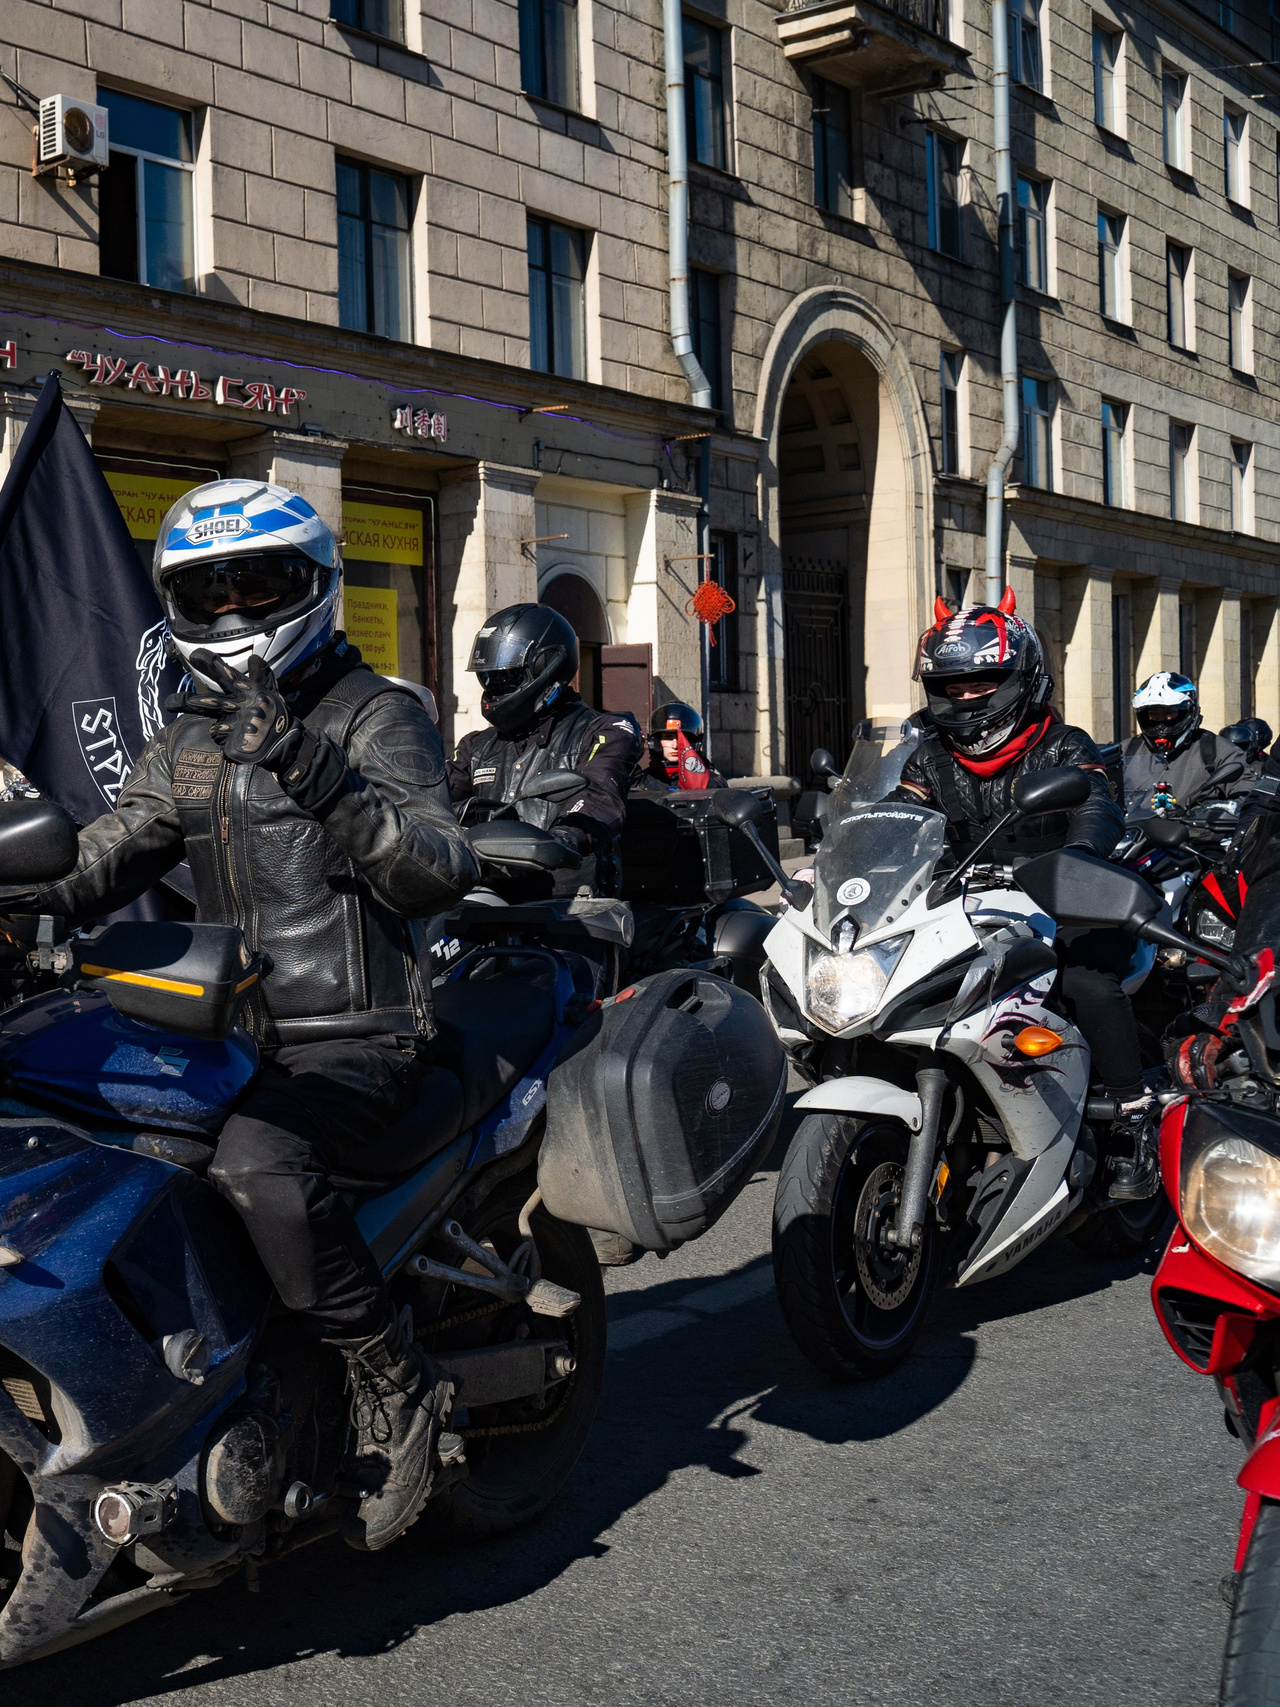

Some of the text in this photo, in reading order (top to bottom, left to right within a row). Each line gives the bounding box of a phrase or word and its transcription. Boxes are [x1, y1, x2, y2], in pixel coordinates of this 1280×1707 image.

[119, 505, 156, 525] КАЯ
[194, 518, 241, 539] SHOEI
[382, 533, 420, 552] КУХНЯ
[347, 598, 389, 612] Праздники,
[352, 612, 385, 626] банкеты,
[347, 626, 391, 639] бизнес-ланч
[374, 644, 386, 655] руб
[938, 643, 966, 655] Airoh
[1005, 1208, 1062, 1263] YAMAHA
